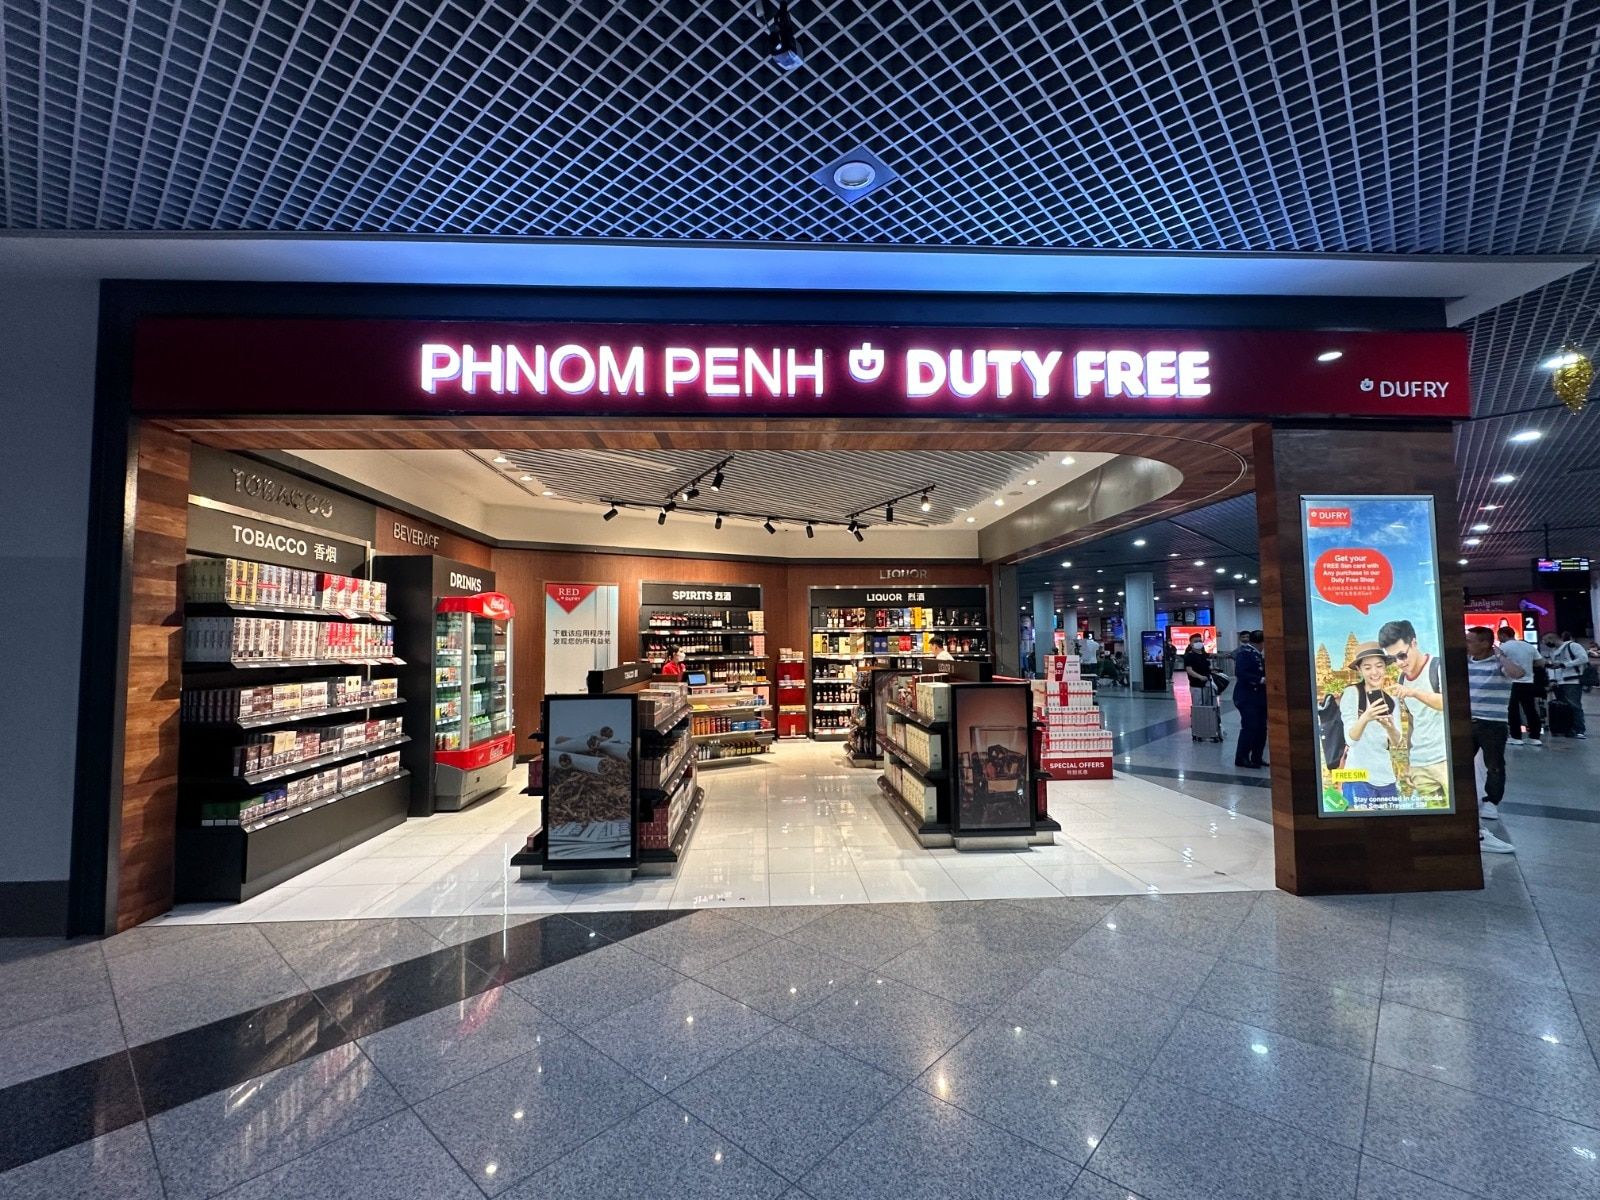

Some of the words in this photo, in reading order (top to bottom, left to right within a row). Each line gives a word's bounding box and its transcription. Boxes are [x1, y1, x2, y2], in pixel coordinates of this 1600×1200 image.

[420, 344, 645, 395] PHNOM
[664, 347, 823, 397] PENH
[906, 349, 1063, 398] DUTY
[1073, 350, 1212, 399] FREE
[1379, 381, 1449, 398] DUFRY
[231, 467, 333, 518] TOBACCO
[1319, 511, 1348, 520] DUFRY
[232, 525, 307, 556] TOBACCO
[314, 543, 337, 563] 香烟
[880, 569, 927, 580] LIQUOR
[450, 572, 482, 592] DRINKS
[558, 587, 580, 596] RED
[672, 591, 713, 600] SPIRITS
[866, 593, 902, 602] LIQUOR
[1177, 612, 1183, 620] 2
[1525, 617, 1534, 628] 2
[1335, 772, 1354, 780] FREE
[1355, 771, 1366, 779] SIM
[1353, 796, 1368, 804] Stay
[1369, 802, 1387, 810] Smart
